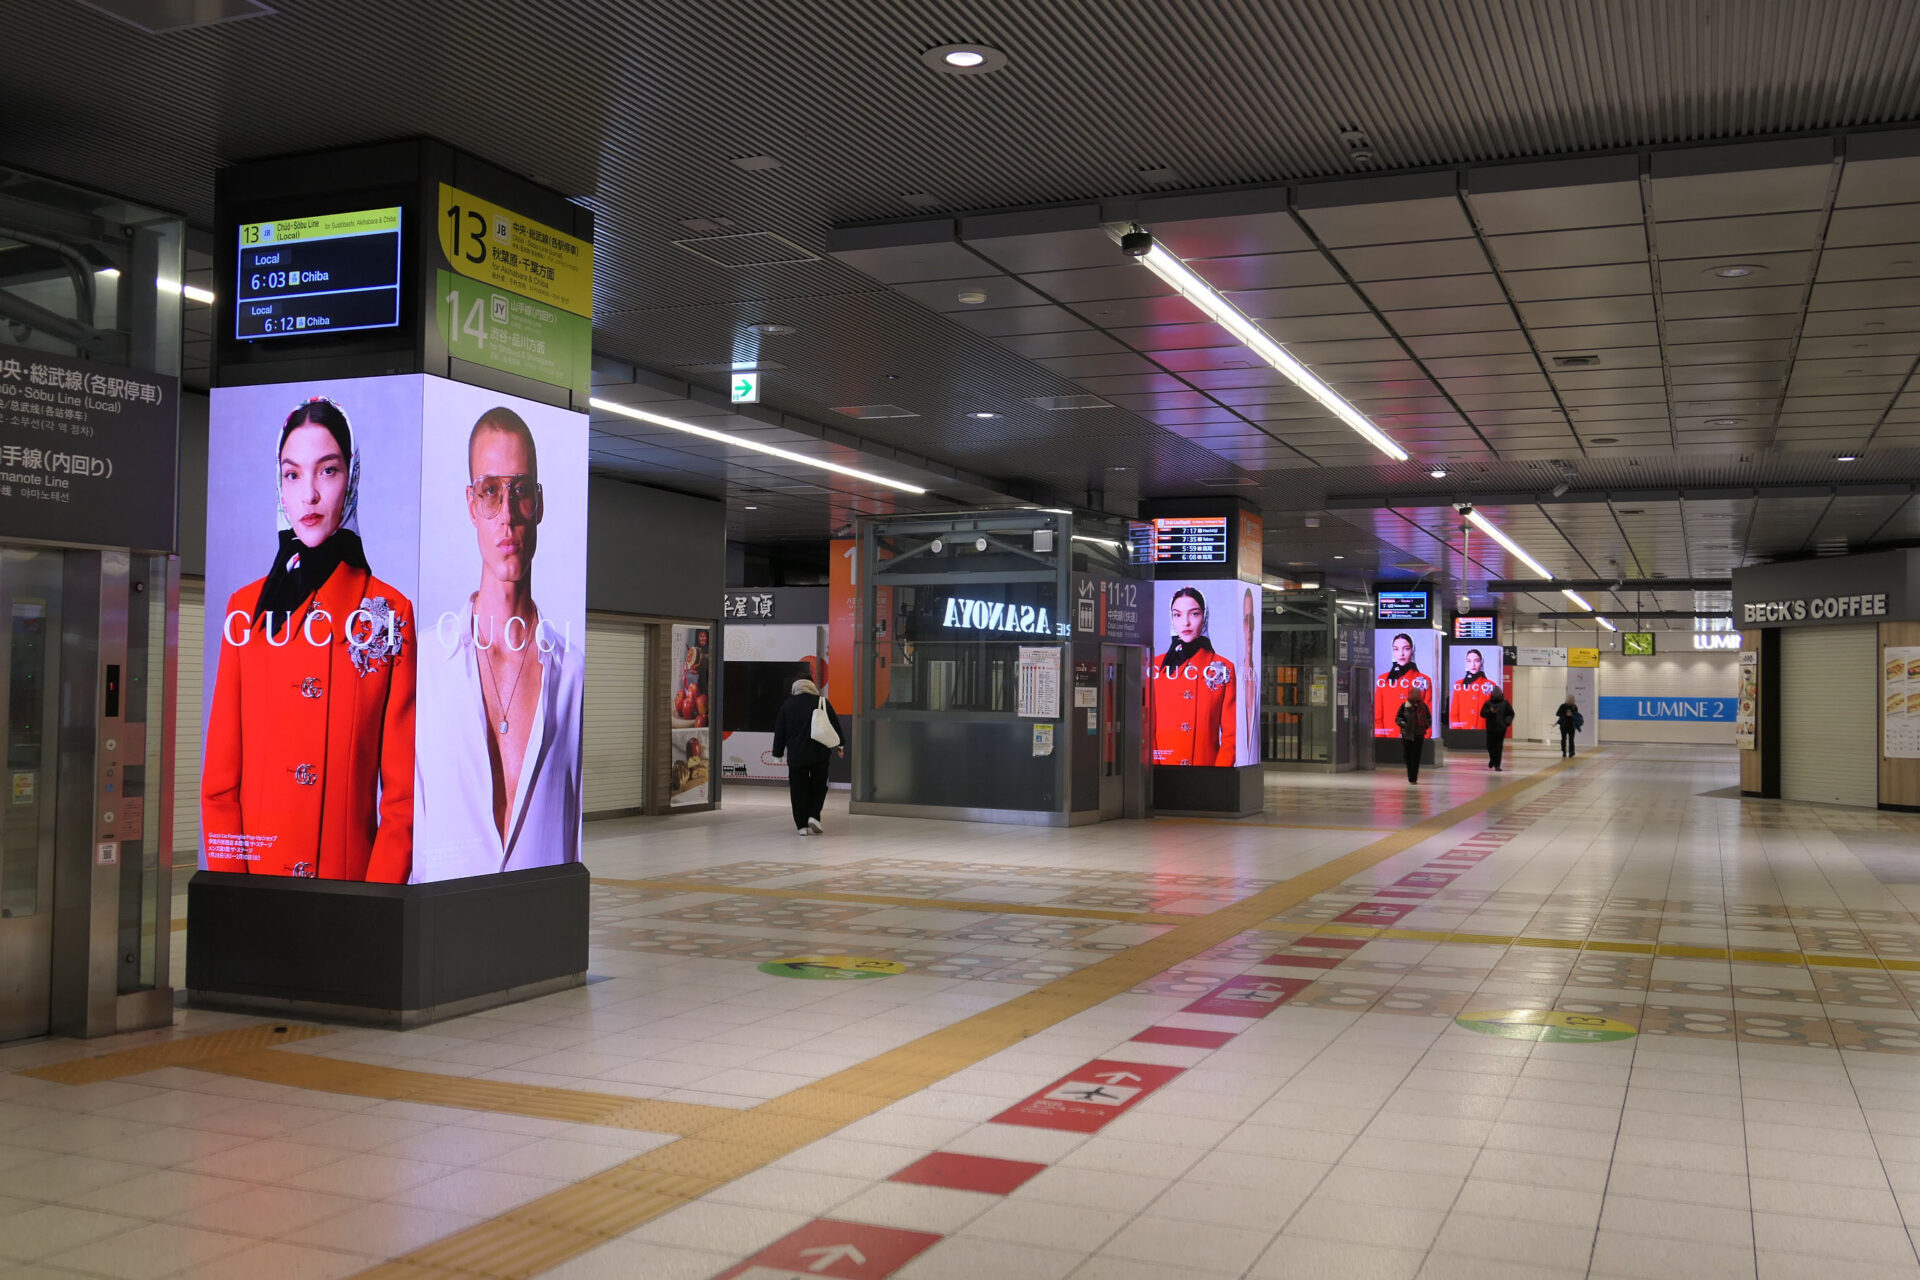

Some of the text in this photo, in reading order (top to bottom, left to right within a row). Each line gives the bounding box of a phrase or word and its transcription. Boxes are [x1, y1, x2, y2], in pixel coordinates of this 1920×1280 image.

[244, 226, 259, 244] 13
[308, 220, 319, 228] Line
[277, 231, 300, 241] (Local)
[447, 205, 487, 264] 13
[496, 223, 506, 236] JB
[255, 253, 280, 266] Local
[251, 272, 286, 290] 6:03
[301, 271, 329, 283] Chiba
[251, 305, 272, 315] Local
[494, 303, 505, 316] JY
[264, 317, 294, 332] 6:12
[307, 316, 330, 326] Chiba
[445, 290, 488, 349] 14
[0, 358, 163, 405] 央・総武線(各駅停車)
[57, 392, 81, 406] Line
[84, 396, 121, 414] (Local)
[0, 445, 113, 479] 手線(内回り)
[45, 475, 69, 489] Line
[1744, 593, 1887, 623] BECK'S COFFEE
[223, 609, 396, 648] GUCCI
[436, 611, 571, 653] GUCCI
[1146, 664, 1227, 681] GUCCI
[1376, 678, 1427, 689] GUCCI
[1454, 683, 1494, 692] GUCCI
[1638, 701, 1724, 718] LUMINE 2
